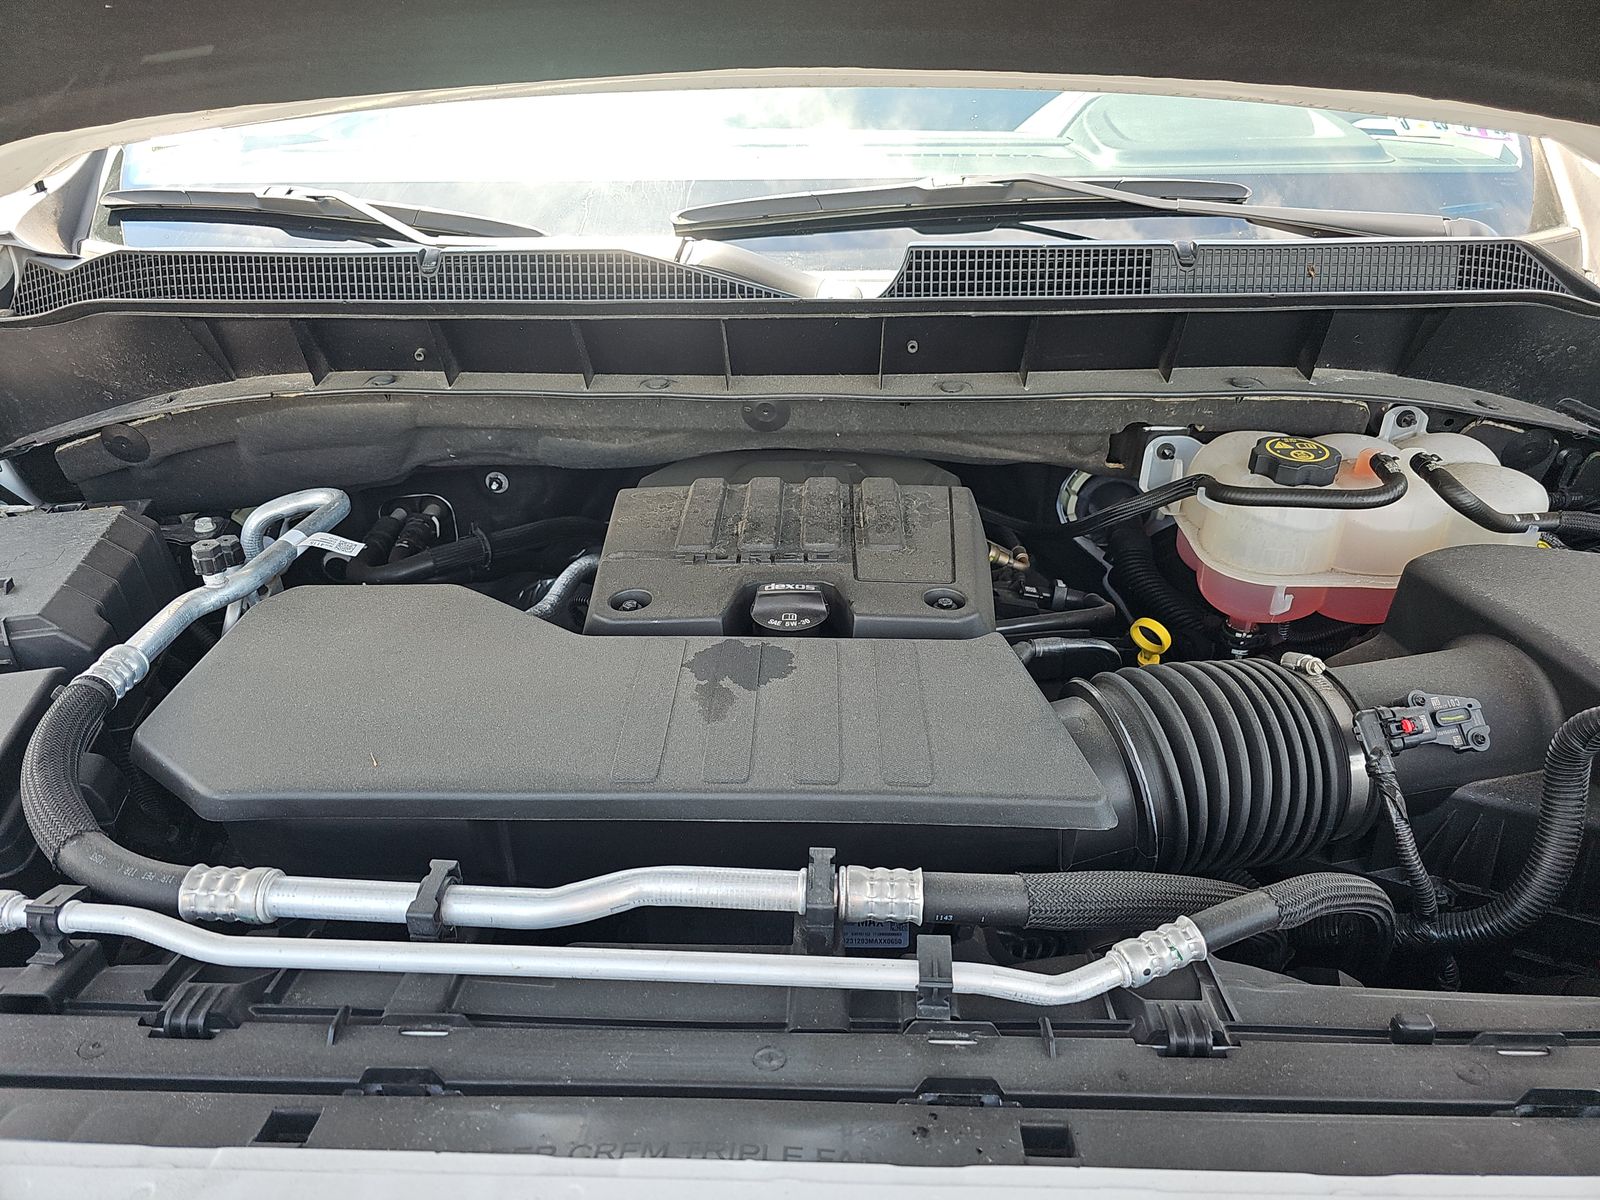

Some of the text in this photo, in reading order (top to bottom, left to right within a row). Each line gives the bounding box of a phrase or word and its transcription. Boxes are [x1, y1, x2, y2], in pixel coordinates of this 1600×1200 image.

[764, 583, 816, 591] dexos
[767, 618, 811, 627] SAE 5W-30
